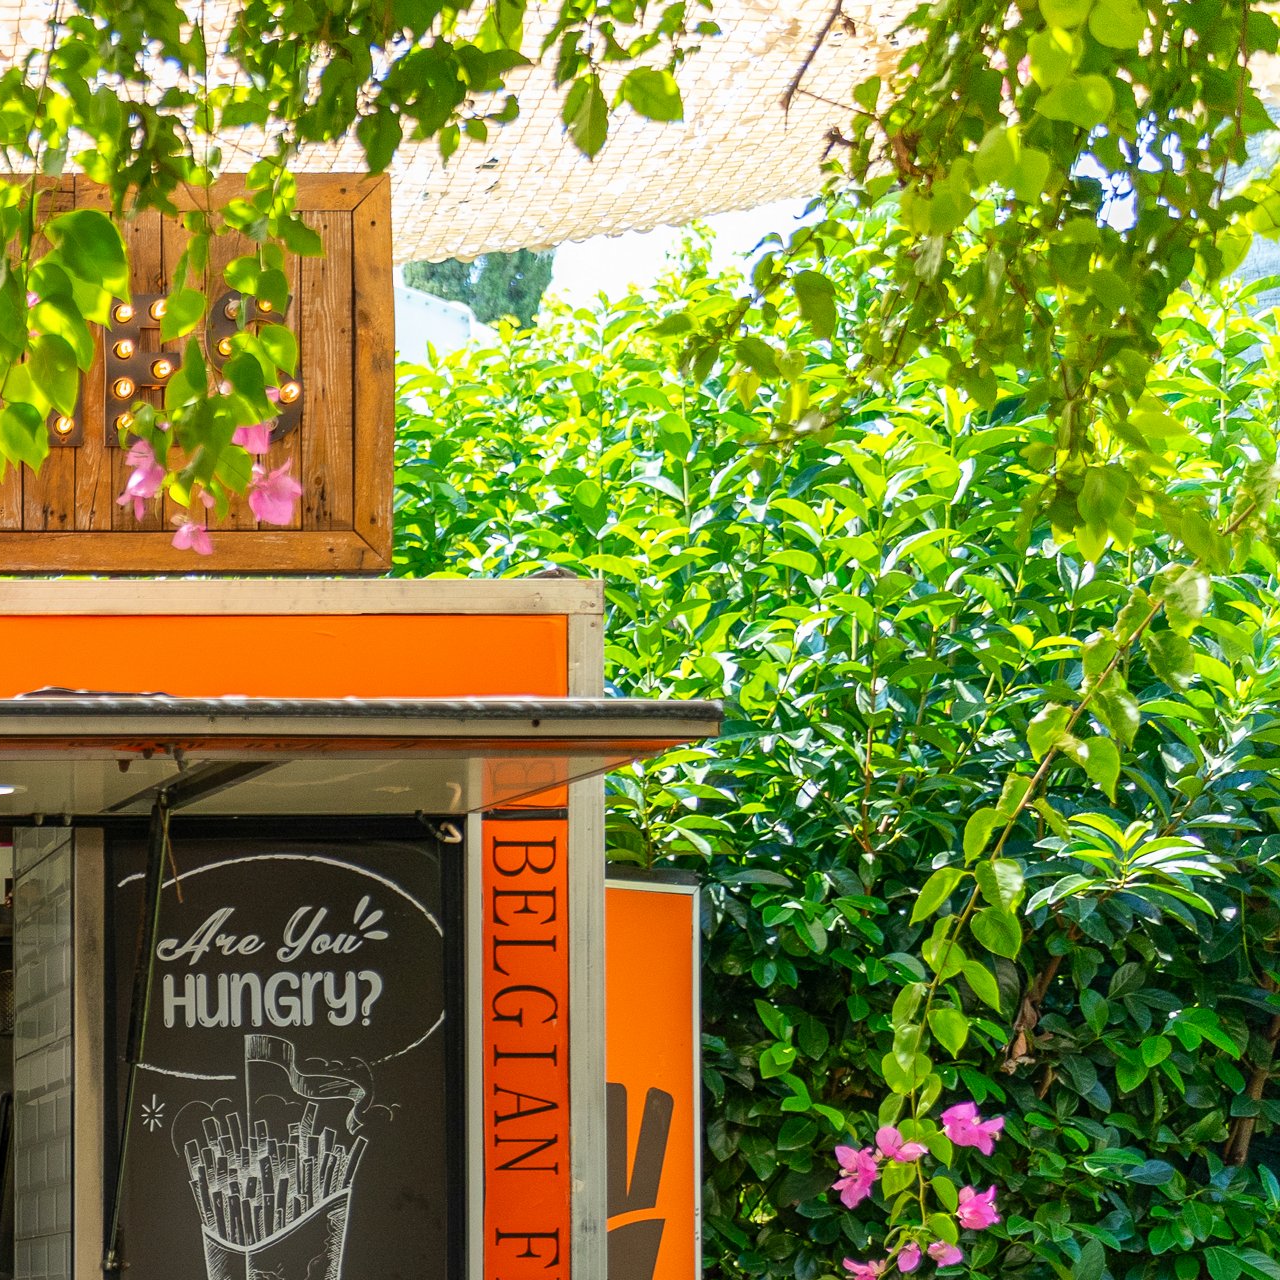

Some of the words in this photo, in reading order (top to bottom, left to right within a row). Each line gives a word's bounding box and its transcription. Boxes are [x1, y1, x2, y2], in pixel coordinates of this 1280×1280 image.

[156, 907, 266, 966] Are
[276, 906, 363, 963] You
[491, 835, 560, 1175] BELGIAN
